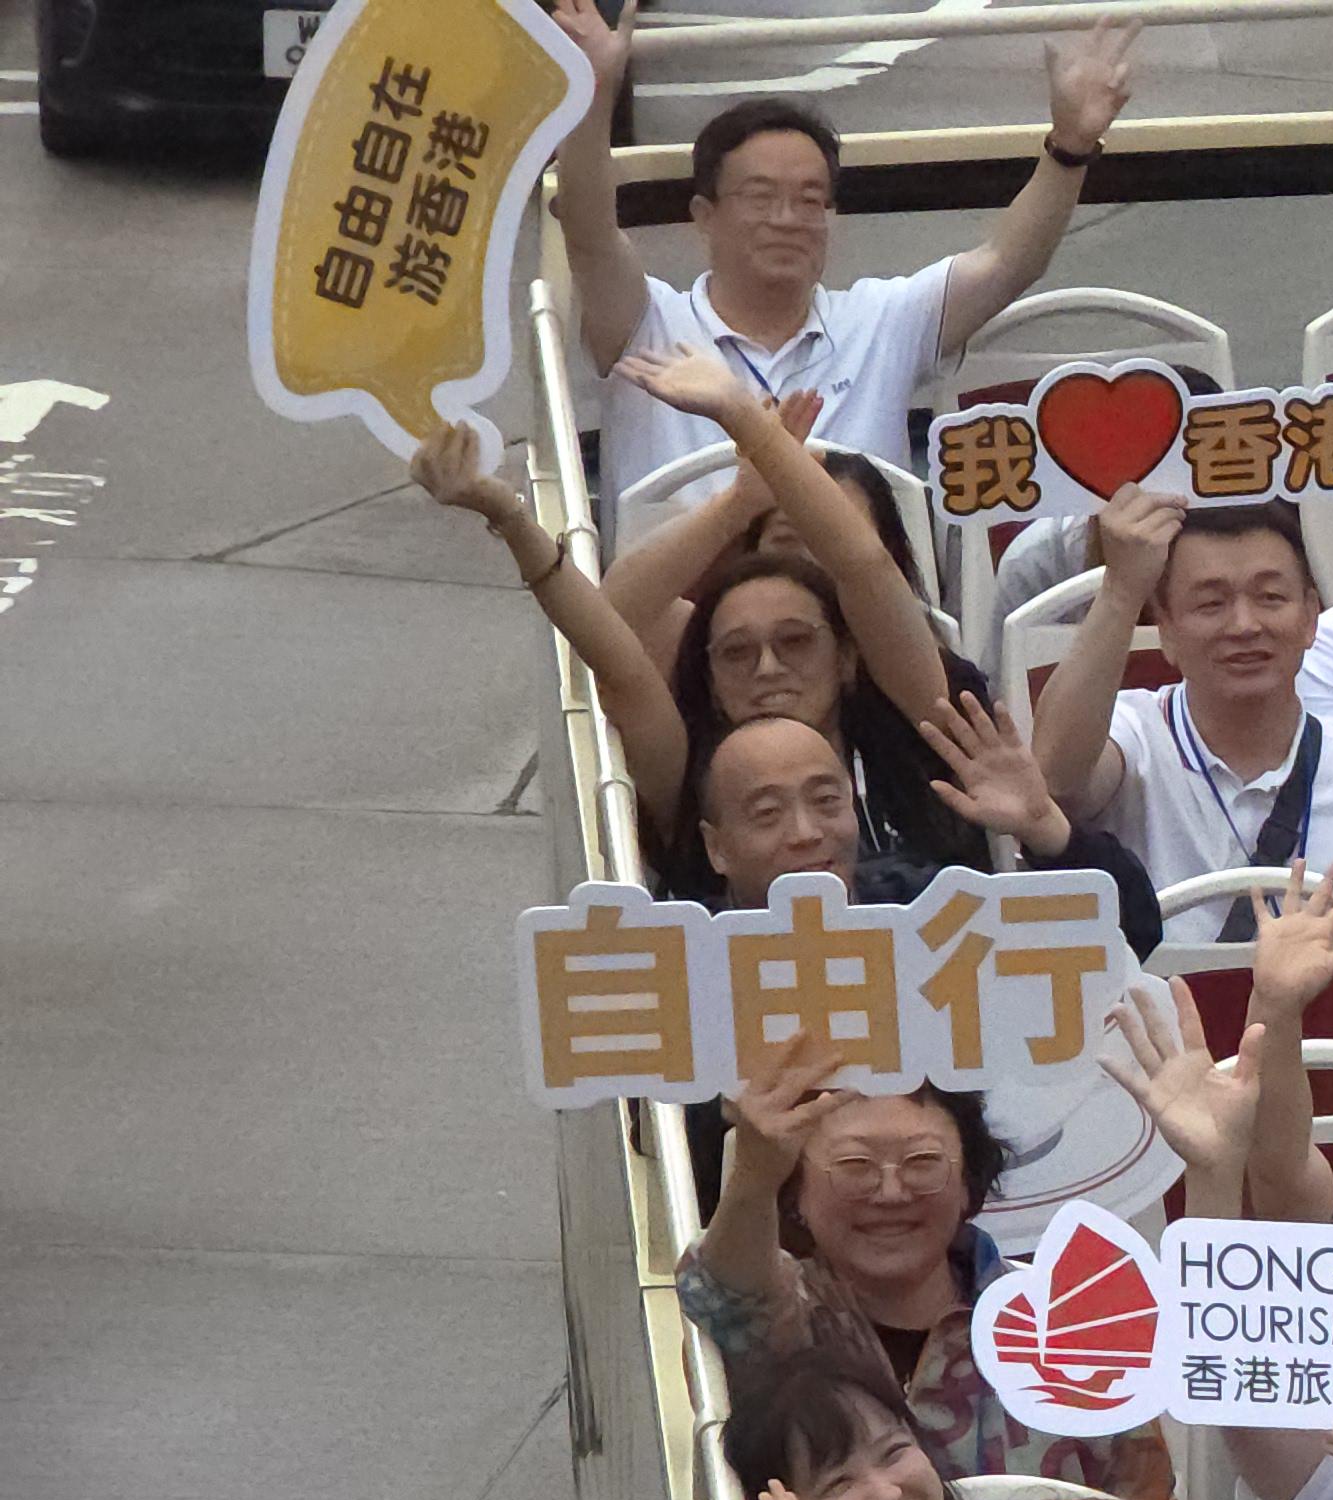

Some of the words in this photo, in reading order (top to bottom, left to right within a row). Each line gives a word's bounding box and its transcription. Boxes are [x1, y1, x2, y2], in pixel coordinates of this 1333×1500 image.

[314, 56, 431, 309] 自由自在
[384, 110, 490, 306] 游香港
[938, 414, 1041, 517] 我
[533, 890, 1109, 1088] 自由行
